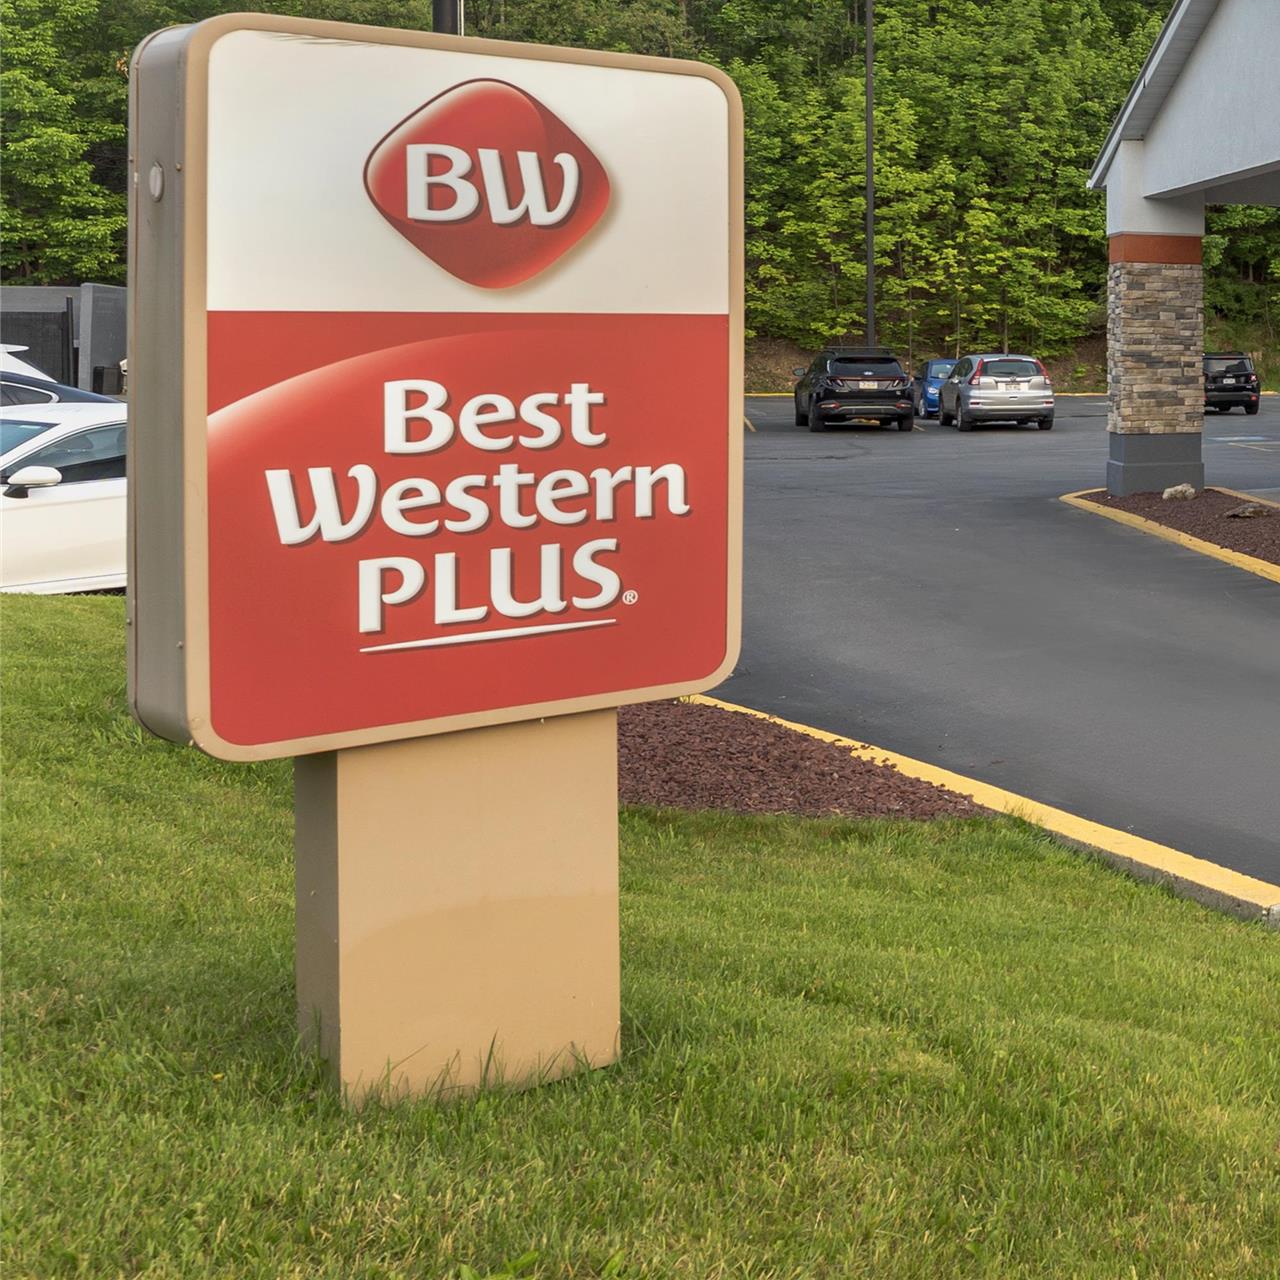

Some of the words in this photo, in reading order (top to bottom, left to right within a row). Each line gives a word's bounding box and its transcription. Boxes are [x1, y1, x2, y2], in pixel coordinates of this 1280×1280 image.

[405, 143, 580, 227] BW
[383, 379, 607, 454] Best
[264, 462, 690, 545] Western
